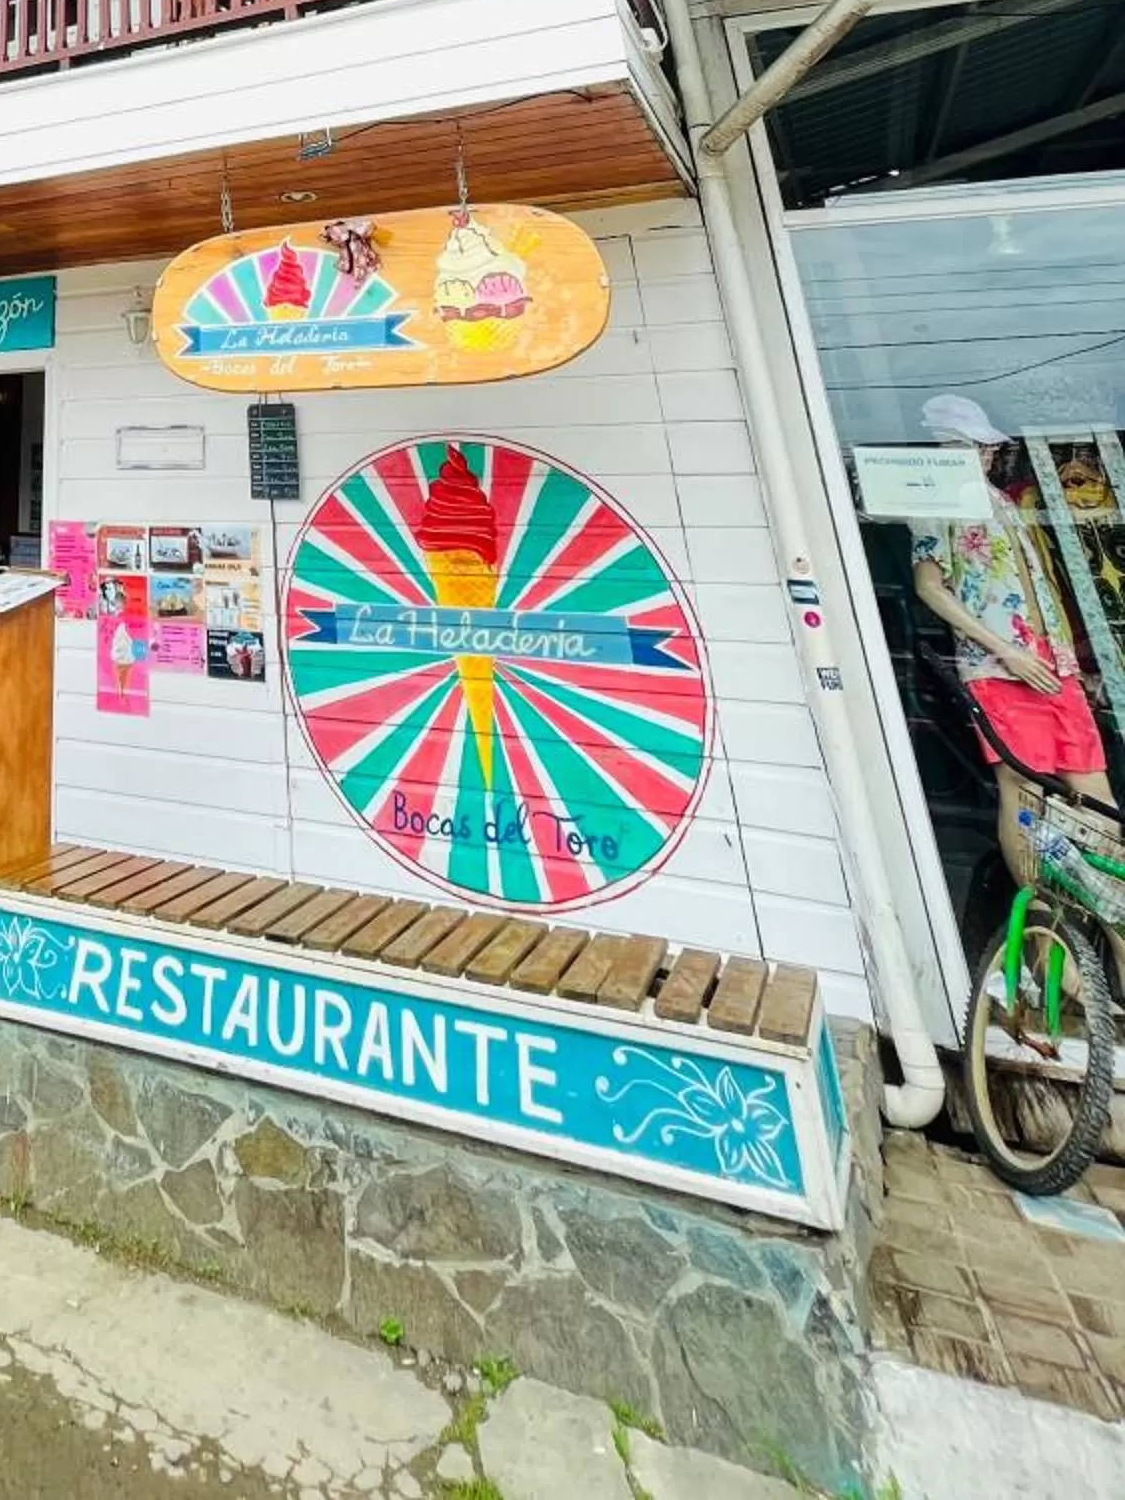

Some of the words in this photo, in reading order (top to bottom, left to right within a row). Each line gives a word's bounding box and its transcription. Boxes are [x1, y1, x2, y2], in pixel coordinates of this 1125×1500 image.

[220, 329, 248, 350] La
[348, 604, 395, 644] La
[392, 789, 472, 841] Bocas
[483, 802, 532, 845] del
[530, 810, 619, 861] Toro
[69, 938, 564, 1126] RESTAURANTE
